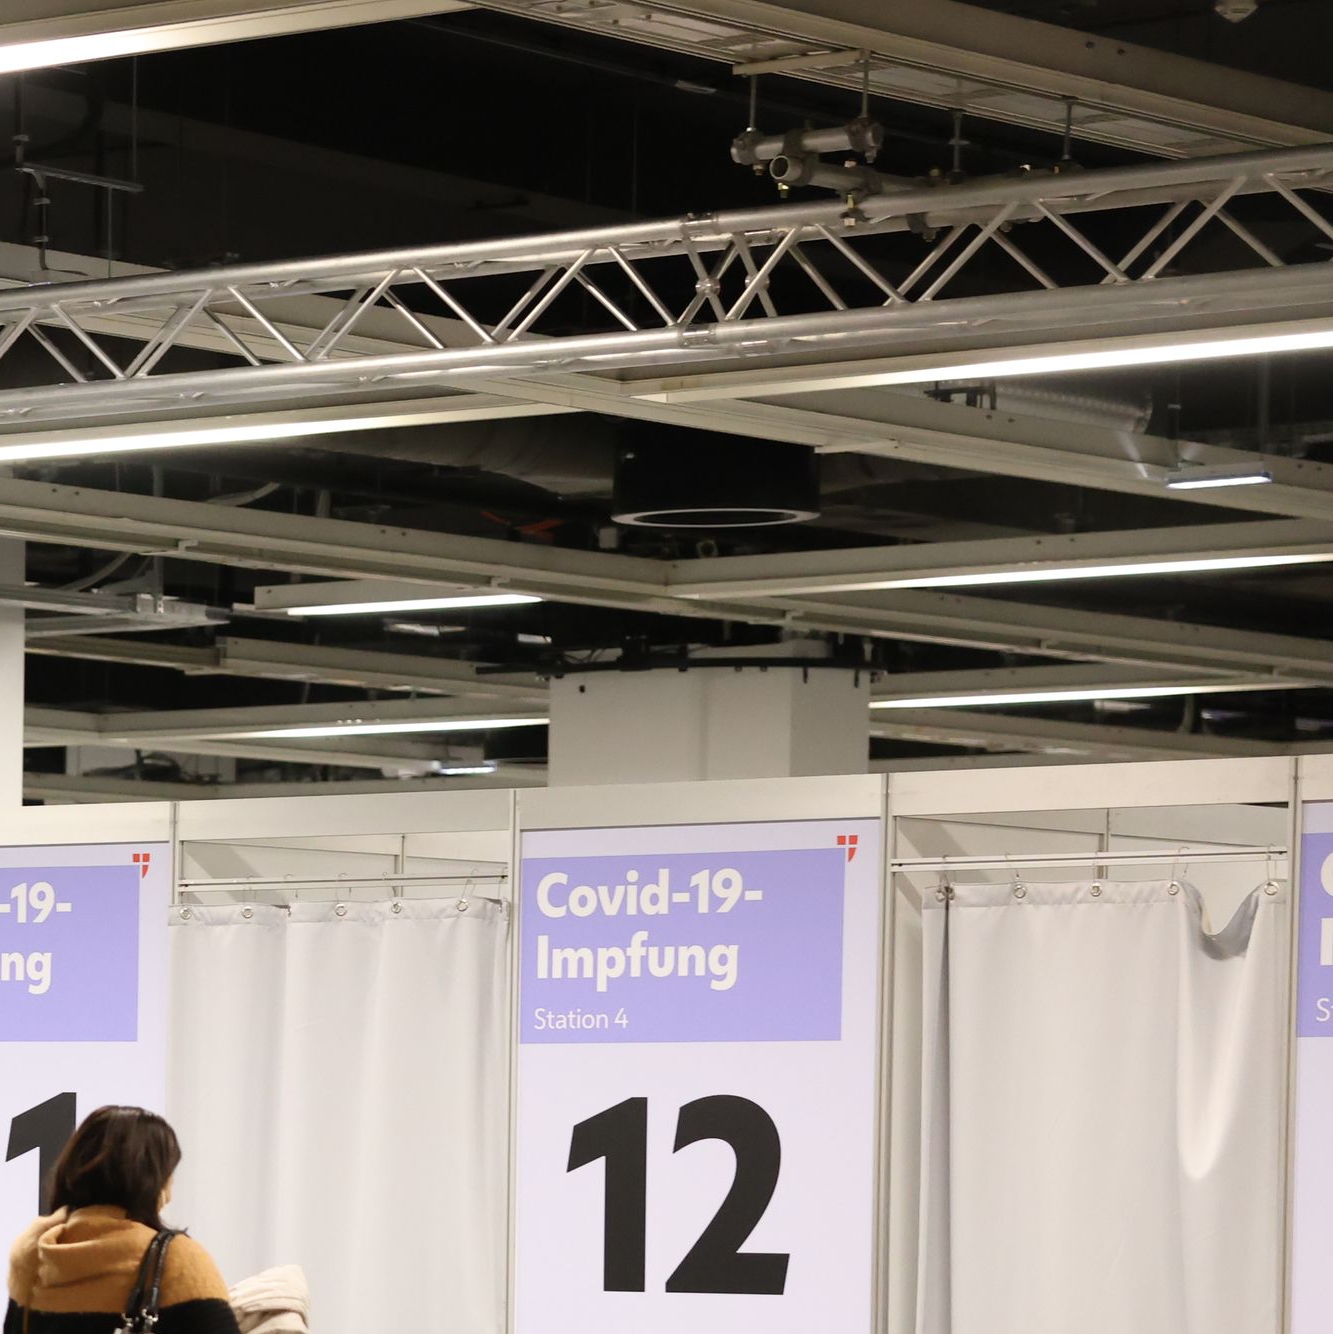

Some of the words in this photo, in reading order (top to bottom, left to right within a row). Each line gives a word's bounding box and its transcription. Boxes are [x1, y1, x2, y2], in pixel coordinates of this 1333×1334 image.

[536, 868, 763, 918] Covid-19-
[537, 930, 739, 993] Impfung
[533, 1007, 609, 1030] Station
[614, 1007, 629, 1029] 4
[566, 1094, 791, 1296] 12
